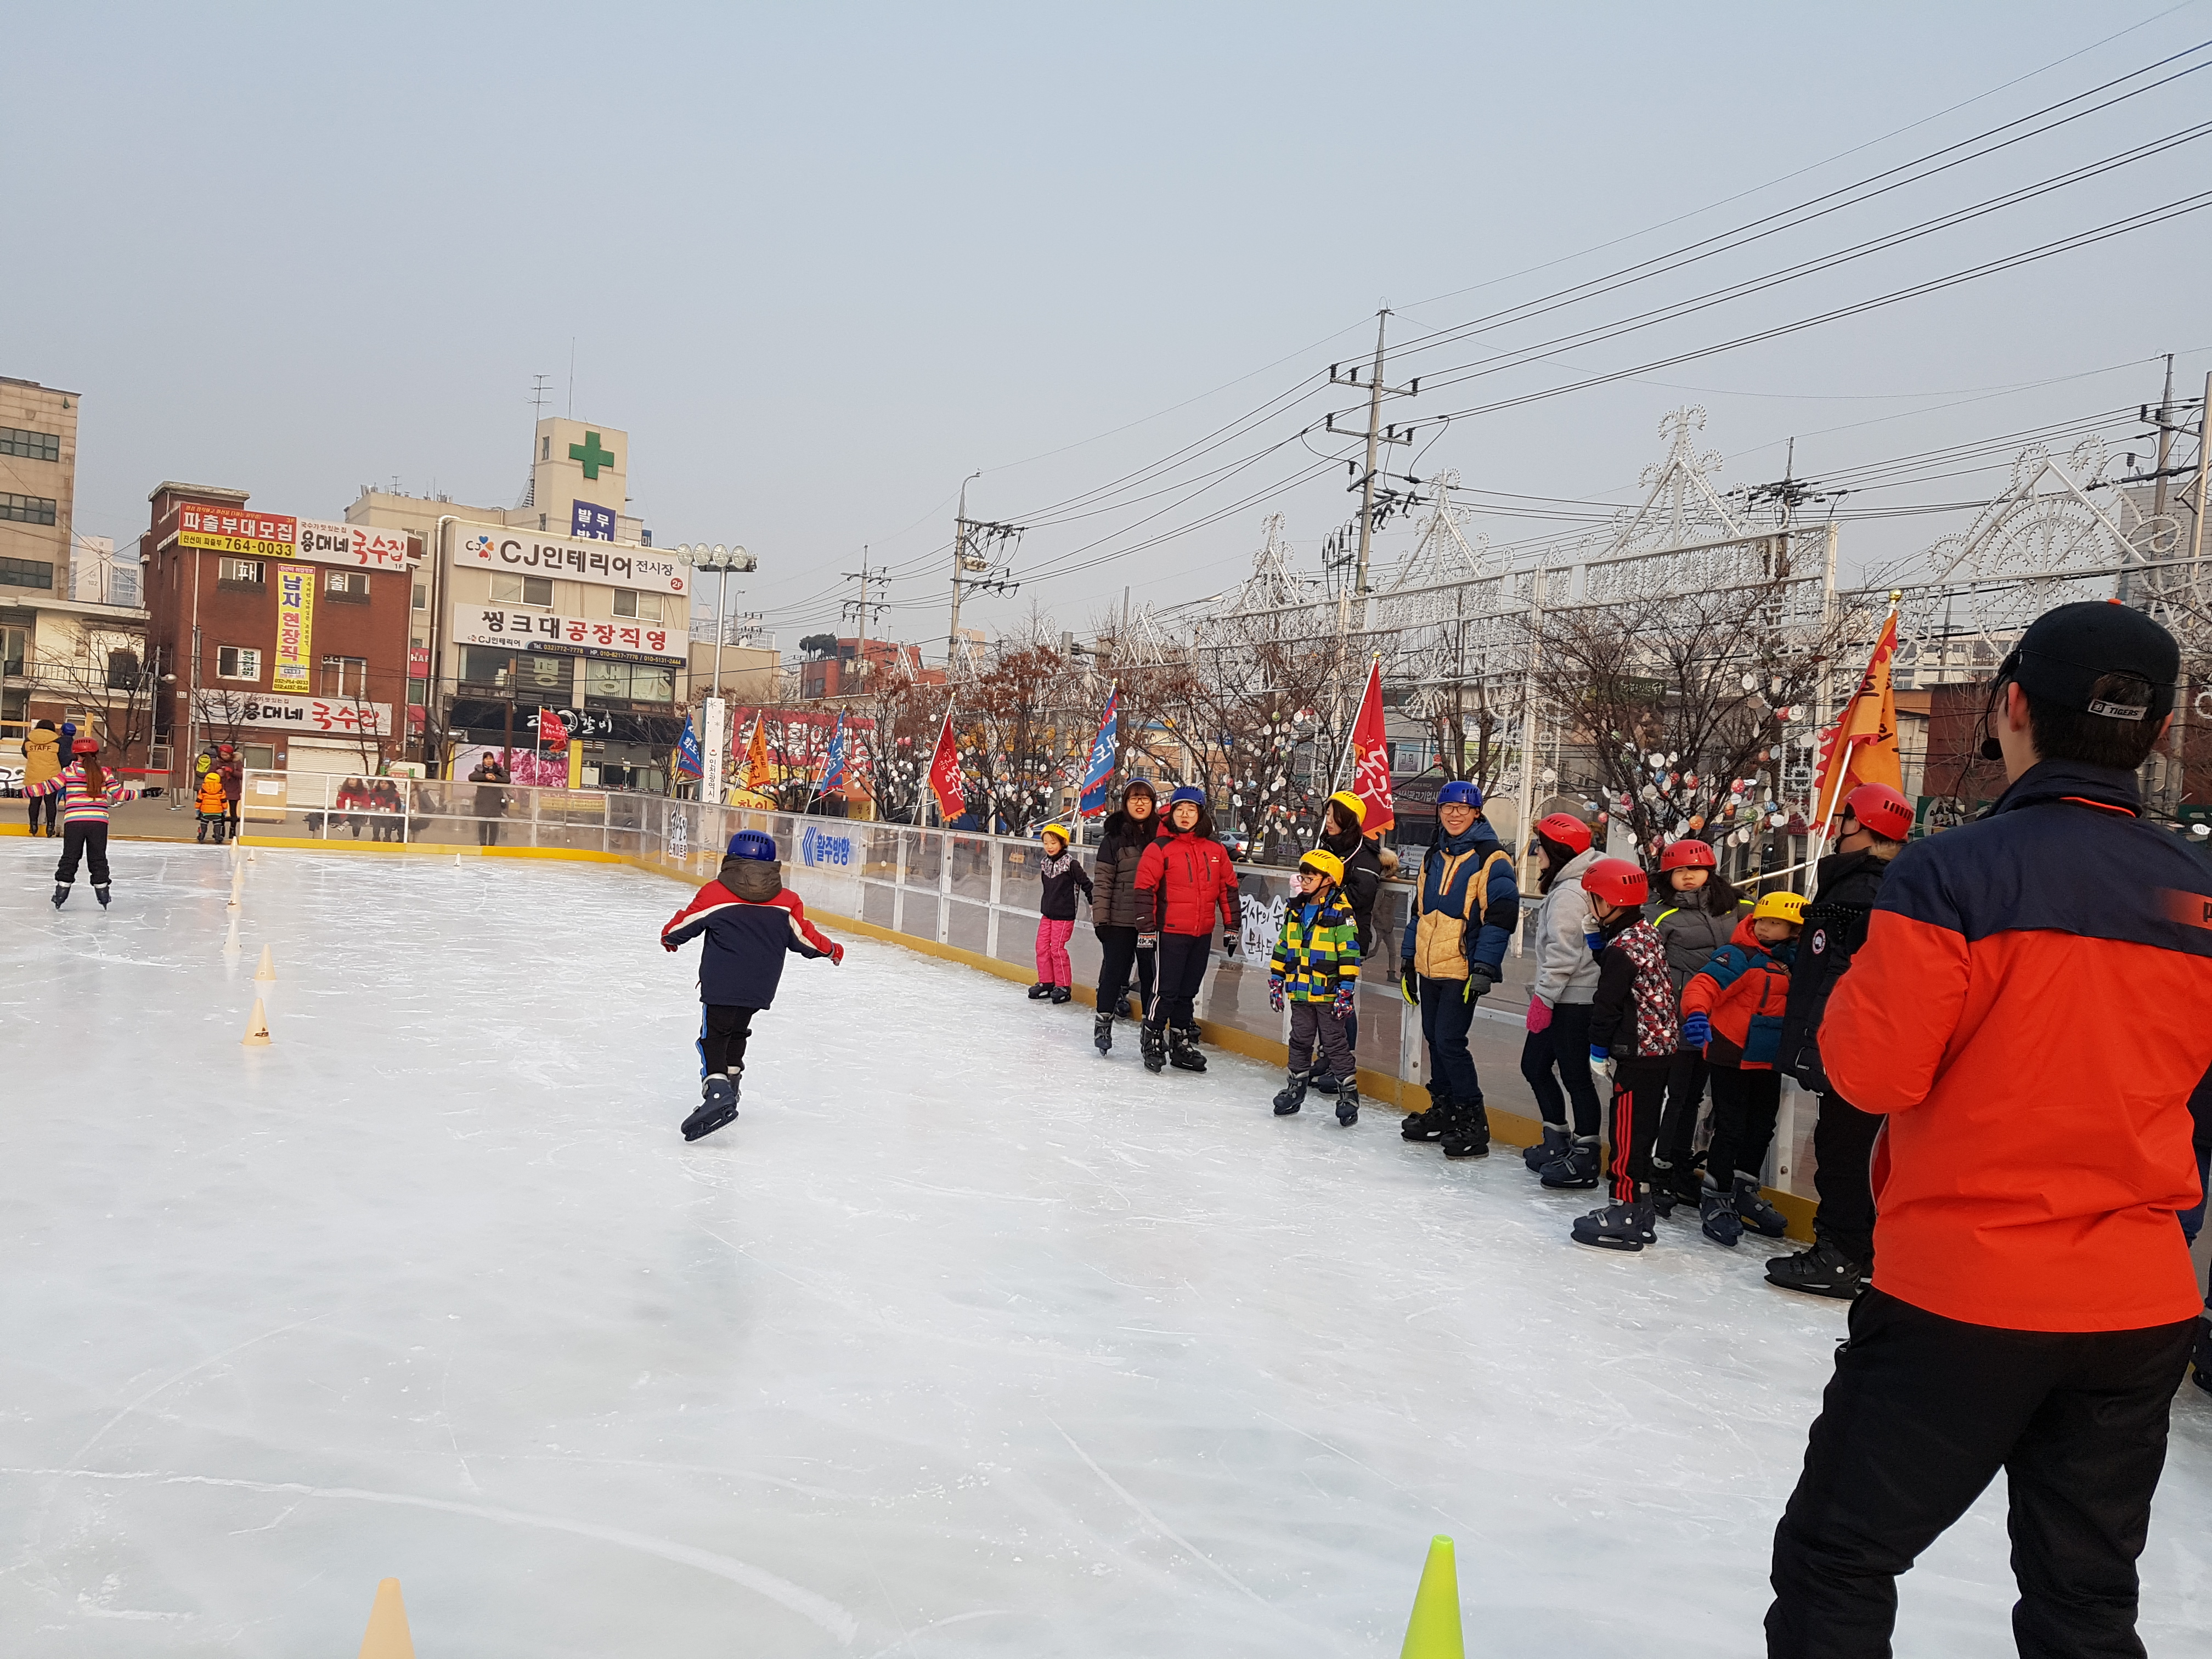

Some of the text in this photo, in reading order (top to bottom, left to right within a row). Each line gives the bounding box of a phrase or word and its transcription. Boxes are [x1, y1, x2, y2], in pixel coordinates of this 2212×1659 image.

[183, 512, 292, 541] 파출부대모집
[301, 522, 319, 530] 국수가
[225, 538, 292, 556] 764-0033
[301, 529, 404, 565] 용대네 국수집
[466, 540, 482, 551] CJ
[500, 540, 674, 579] CJ인테리어 전시장
[282, 575, 302, 607] 남자
[672, 580, 682, 588] 2F
[281, 612, 300, 661] 현장직
[478, 635, 521, 647] CJ인테리어
[246, 702, 380, 730] 용대네 국수집
[2109, 707, 2139, 716] TIGERS
[708, 759, 716, 798] 인천광역시
[669, 843, 687, 858] 스케이트장
[817, 833, 850, 866] 활주방향
[1240, 900, 1286, 932] 역사의 숨
[1245, 927, 1272, 962] 문화도
